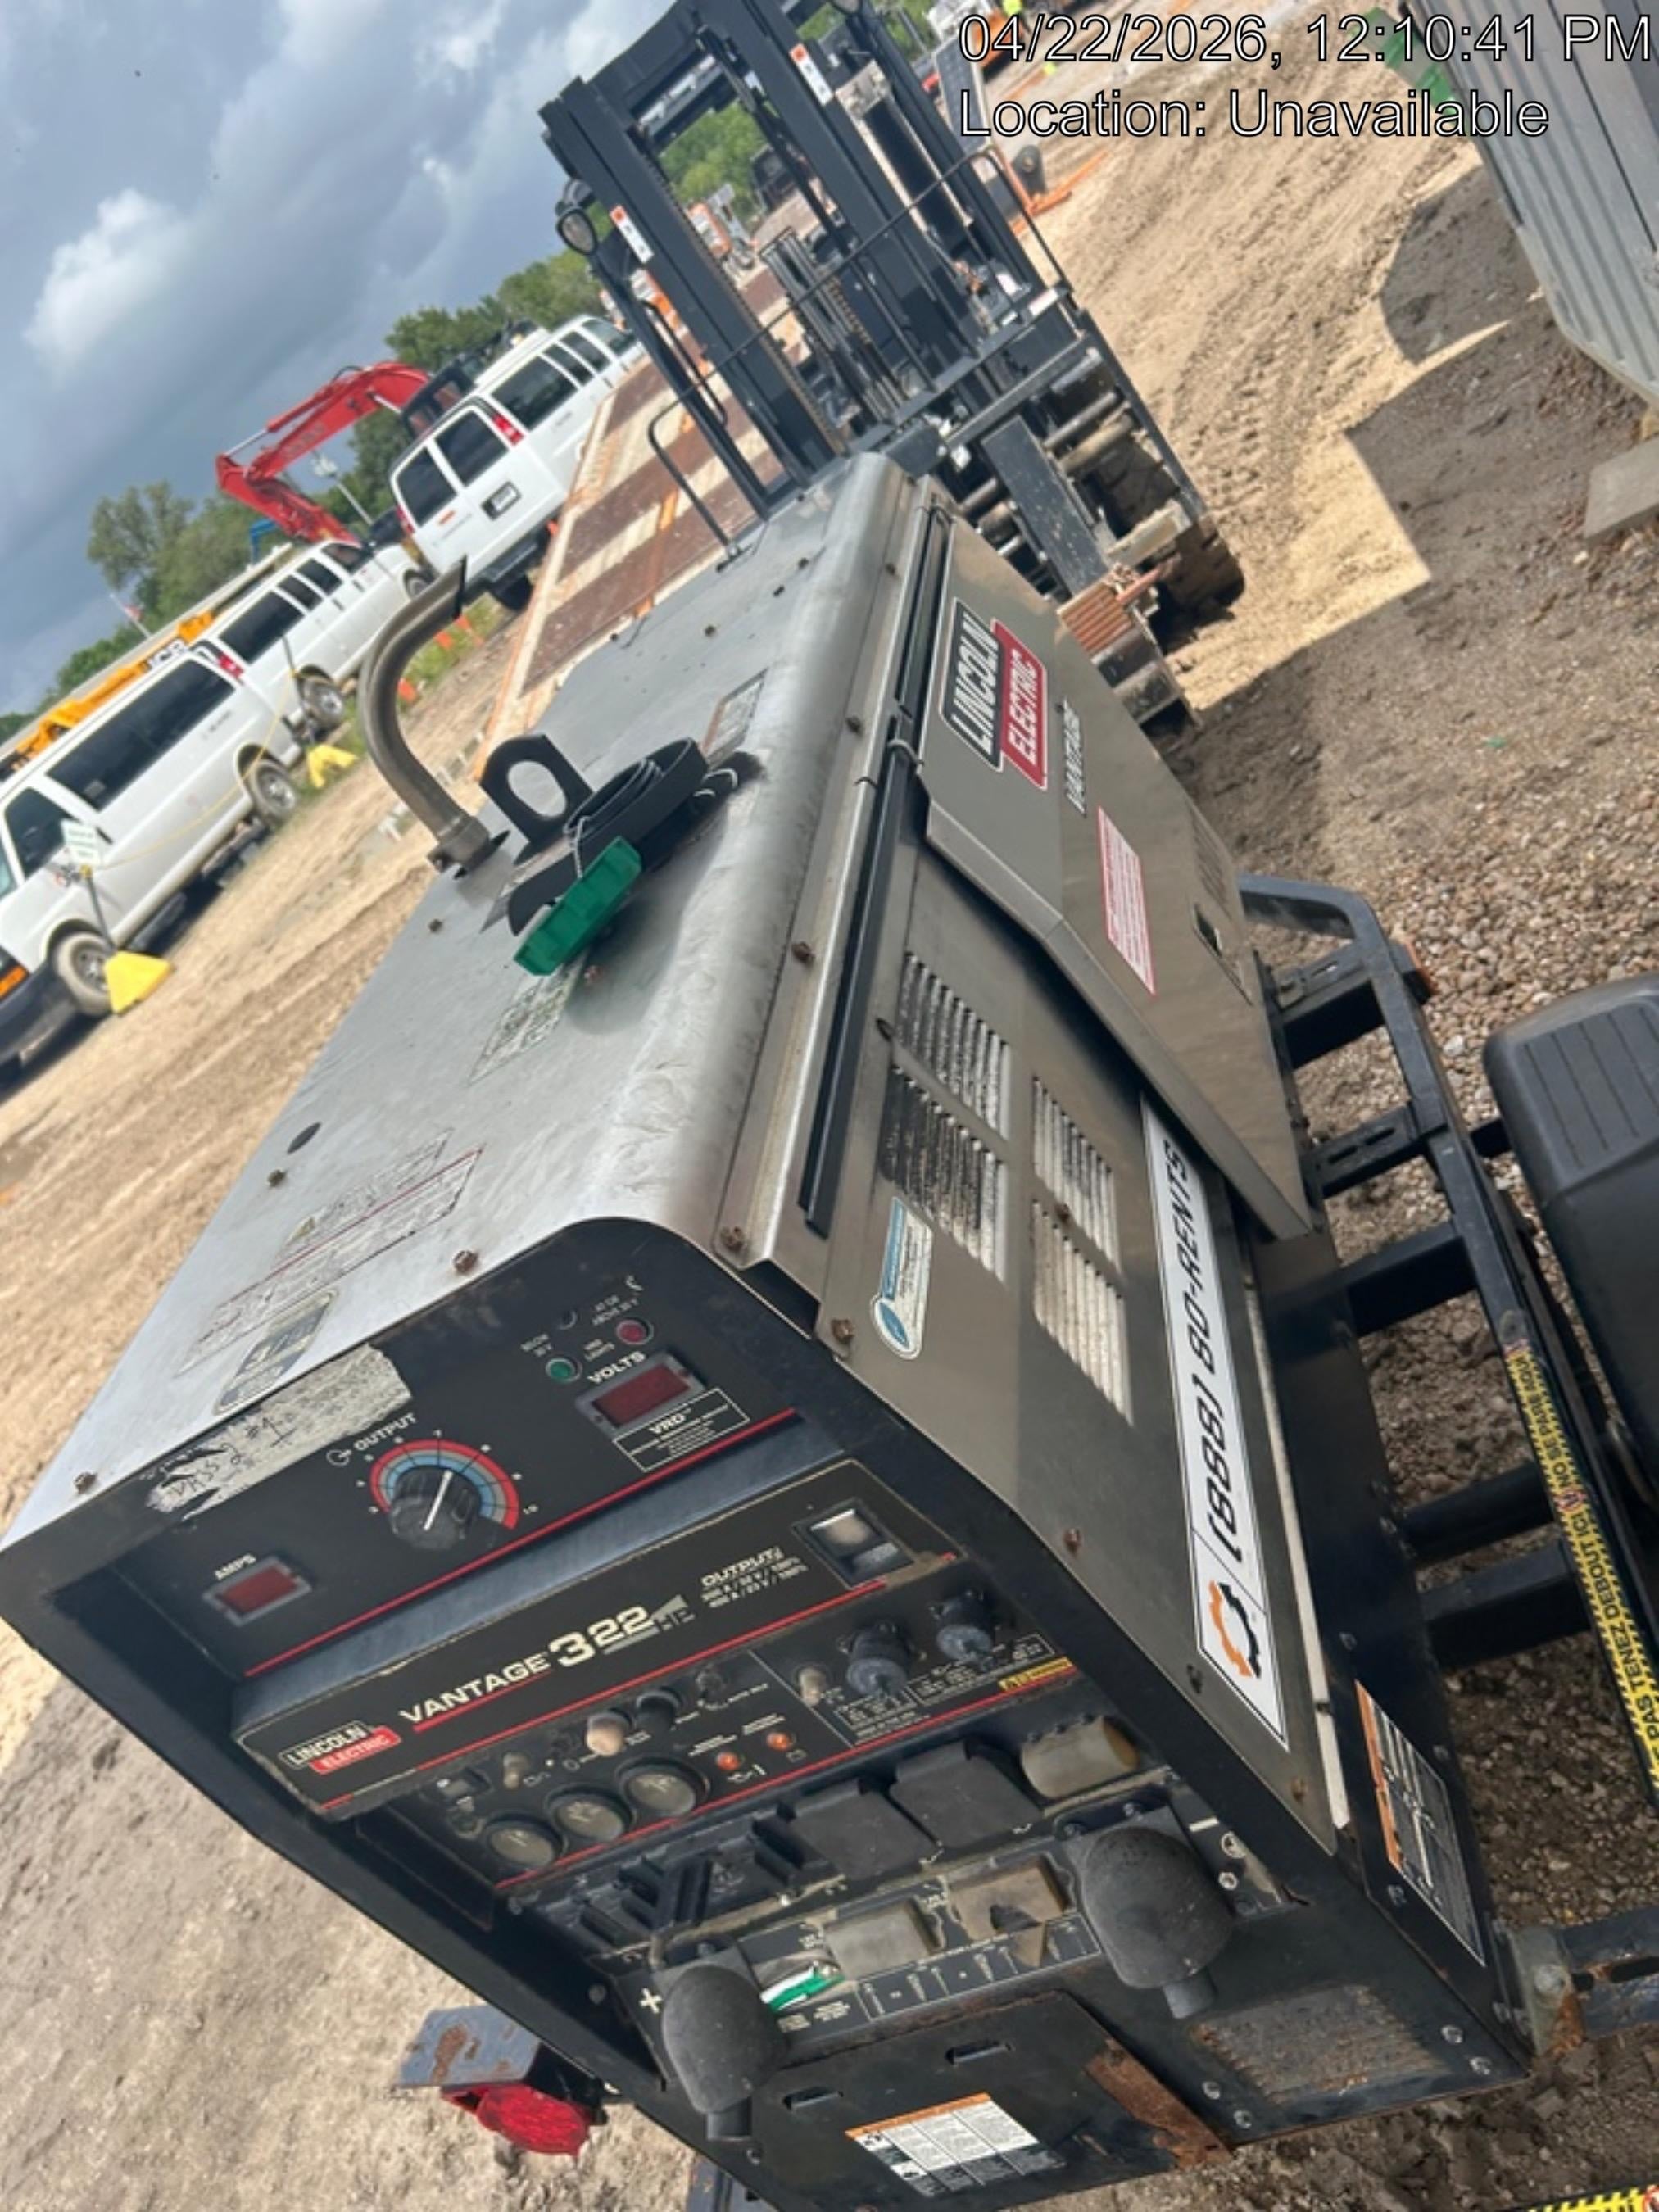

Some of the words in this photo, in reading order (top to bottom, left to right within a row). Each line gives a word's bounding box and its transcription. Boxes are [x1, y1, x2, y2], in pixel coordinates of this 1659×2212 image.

[950, 611, 999, 756] LINCOLN
[1007, 648, 1039, 767] ELECTRIC
[1163, 1139, 1216, 1376] 80-RENTS
[587, 1351, 646, 1384] VOLTS
[354, 1412, 417, 1452] OUTPUT
[1191, 1372, 1243, 1563] (888)
[1552, 1461, 1570, 1487] NO
[1571, 1512, 1591, 1537] ICI
[215, 1553, 256, 1580] AMPS
[701, 1548, 773, 1586] OUTPUT
[1580, 1541, 1620, 1620] DEBOUT
[399, 1652, 551, 1724] VANTAGE
[548, 1605, 655, 1668] 322
[1610, 1622, 1647, 1693] TENEZ
[287, 1725, 369, 1766] LINCOLN
[320, 1734, 388, 1770] ELECTRIC
